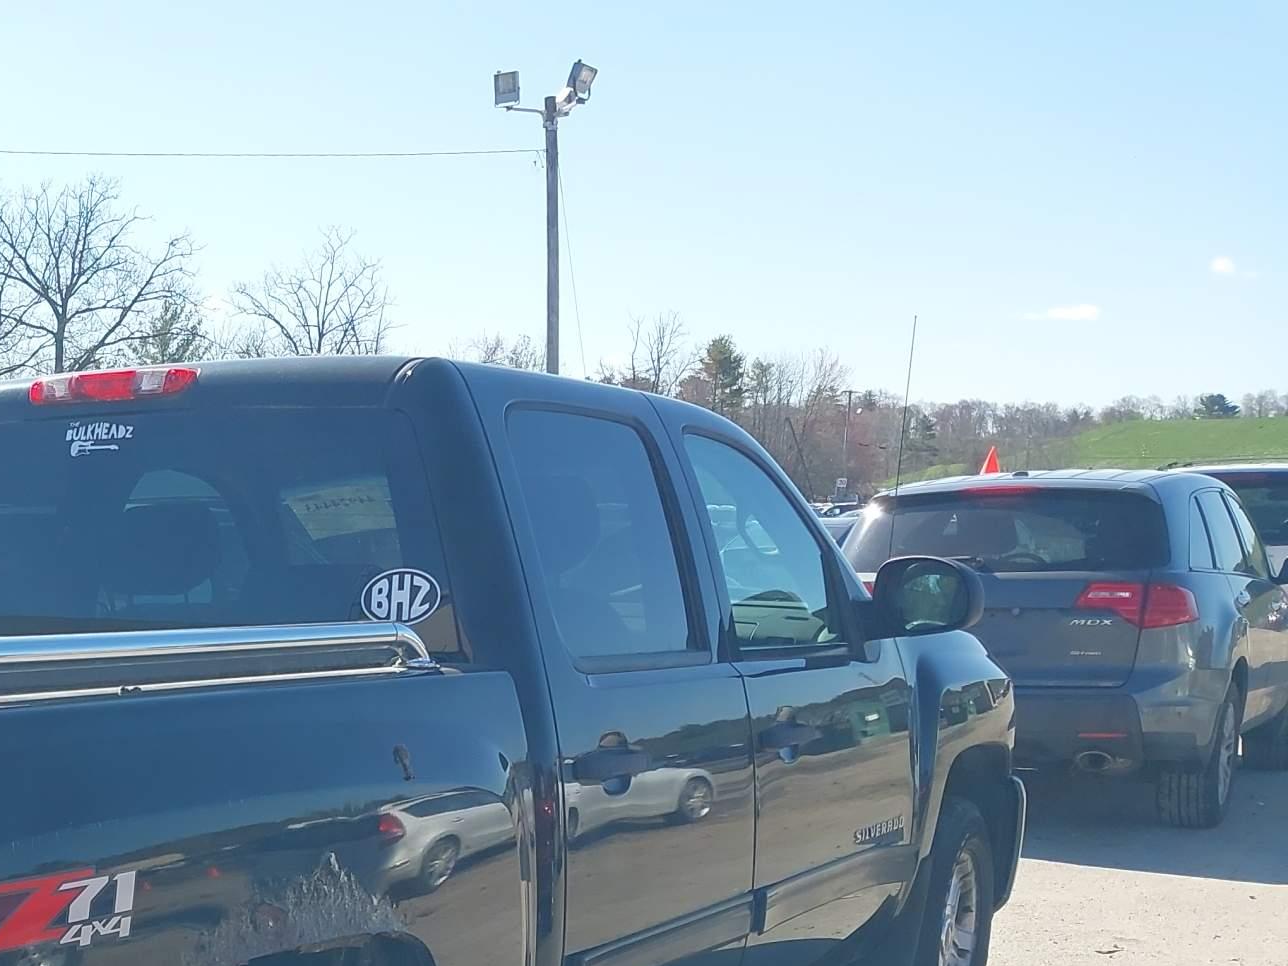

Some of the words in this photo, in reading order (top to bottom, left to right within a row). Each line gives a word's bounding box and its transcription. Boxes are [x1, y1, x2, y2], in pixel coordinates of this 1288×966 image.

[65, 421, 134, 441] BULKHEADZ
[370, 573, 431, 621] BHZ
[1069, 618, 1113, 626] MDX
[854, 815, 905, 844] SILVERADO
